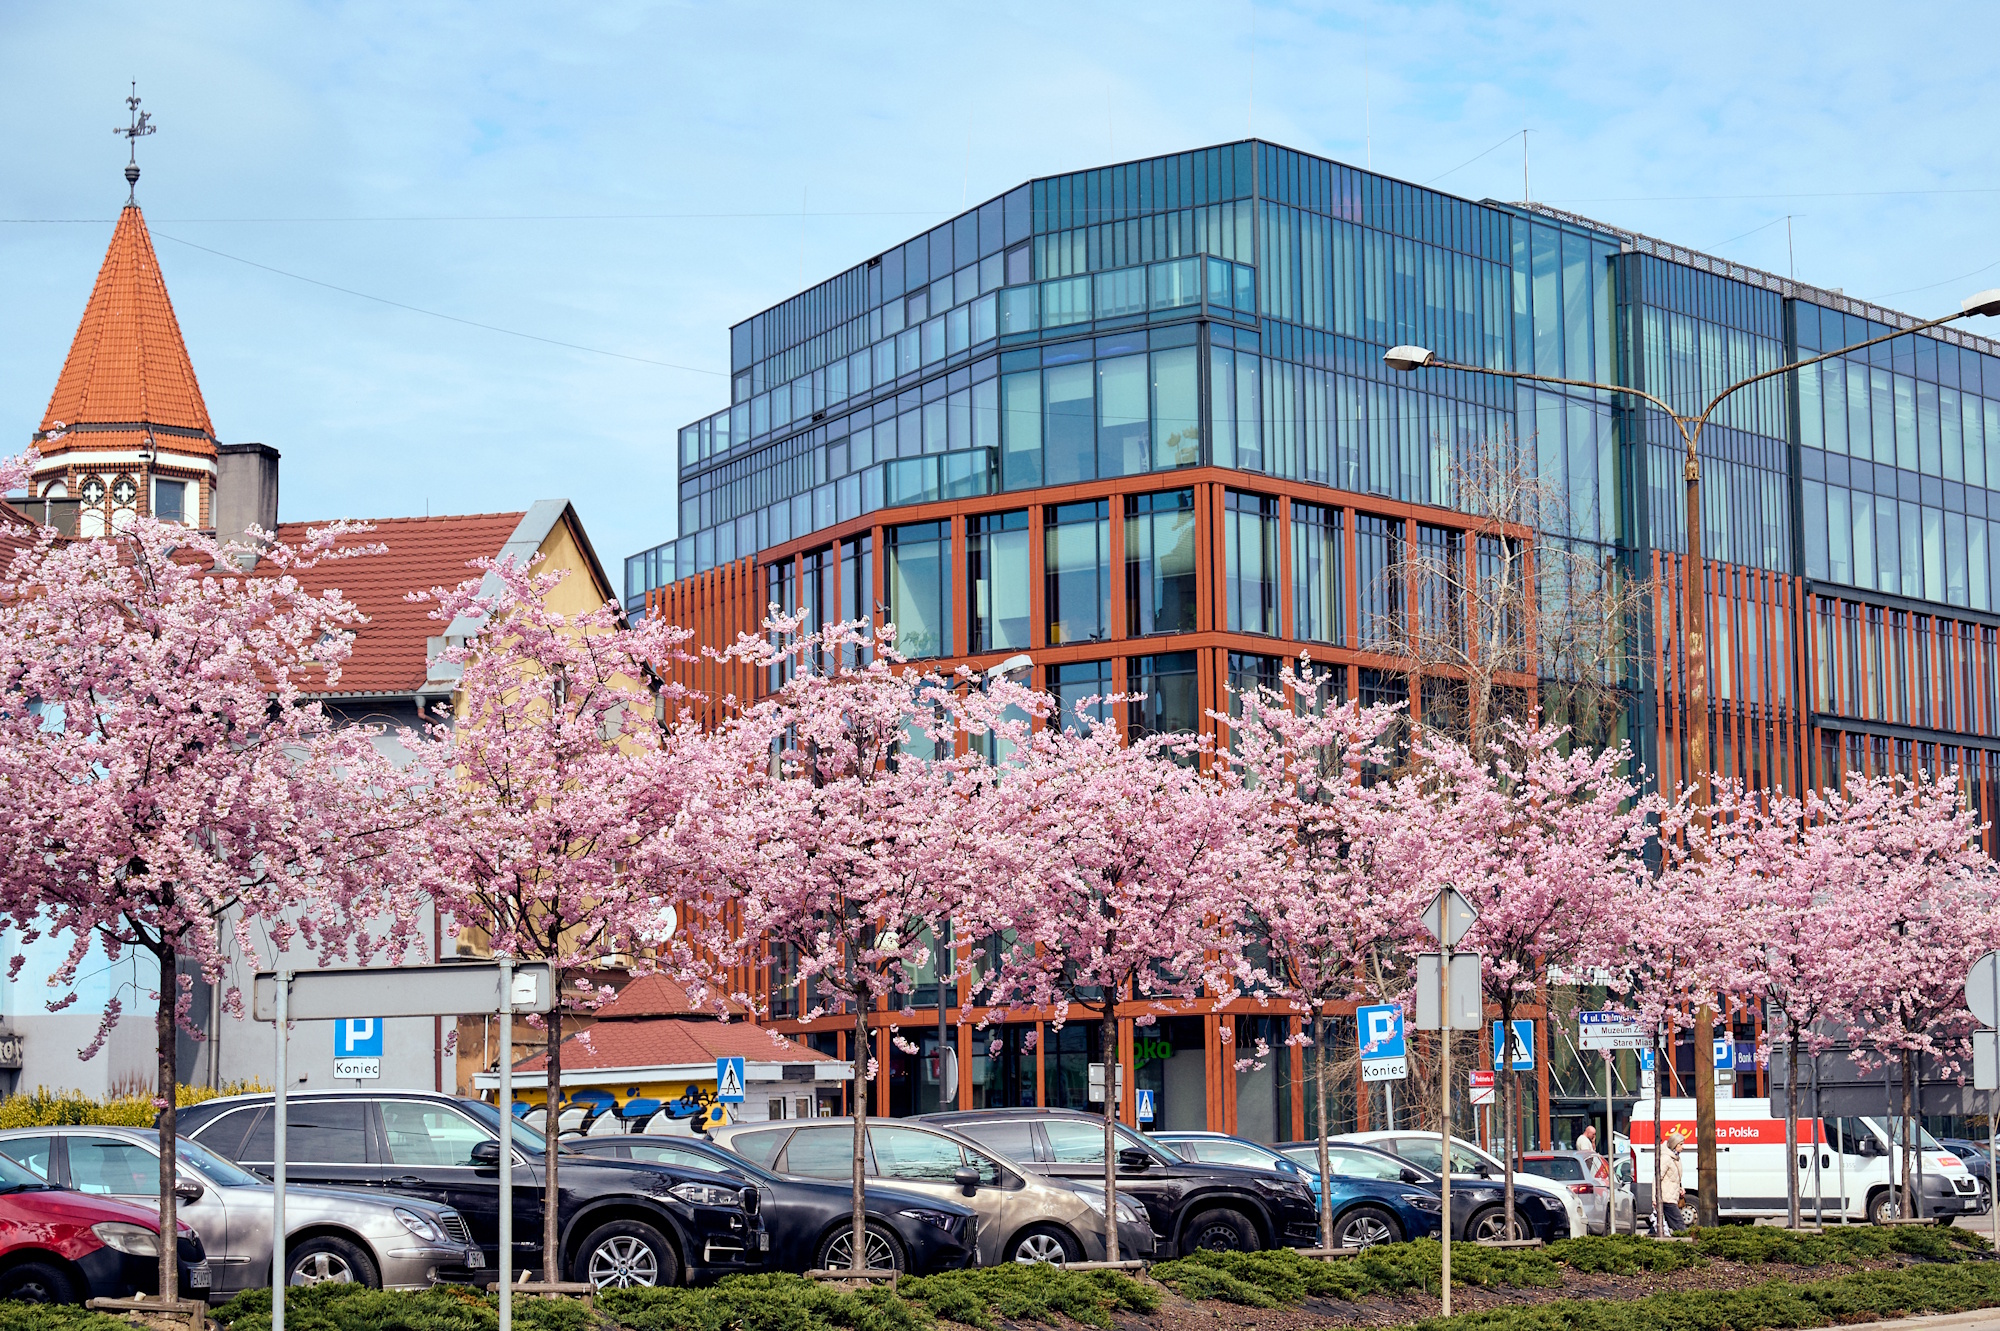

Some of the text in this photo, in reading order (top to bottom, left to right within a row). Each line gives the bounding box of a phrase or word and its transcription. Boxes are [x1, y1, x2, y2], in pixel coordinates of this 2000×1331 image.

[346, 1018, 374, 1051] P
[1368, 1011, 1394, 1052] P
[1613, 1038, 1653, 1047] Stare Mias
[1738, 1052, 1752, 1063] Bank
[336, 1062, 378, 1074] Koniec
[1363, 1063, 1404, 1077] Koniec
[1728, 1126, 1760, 1138] Polska
